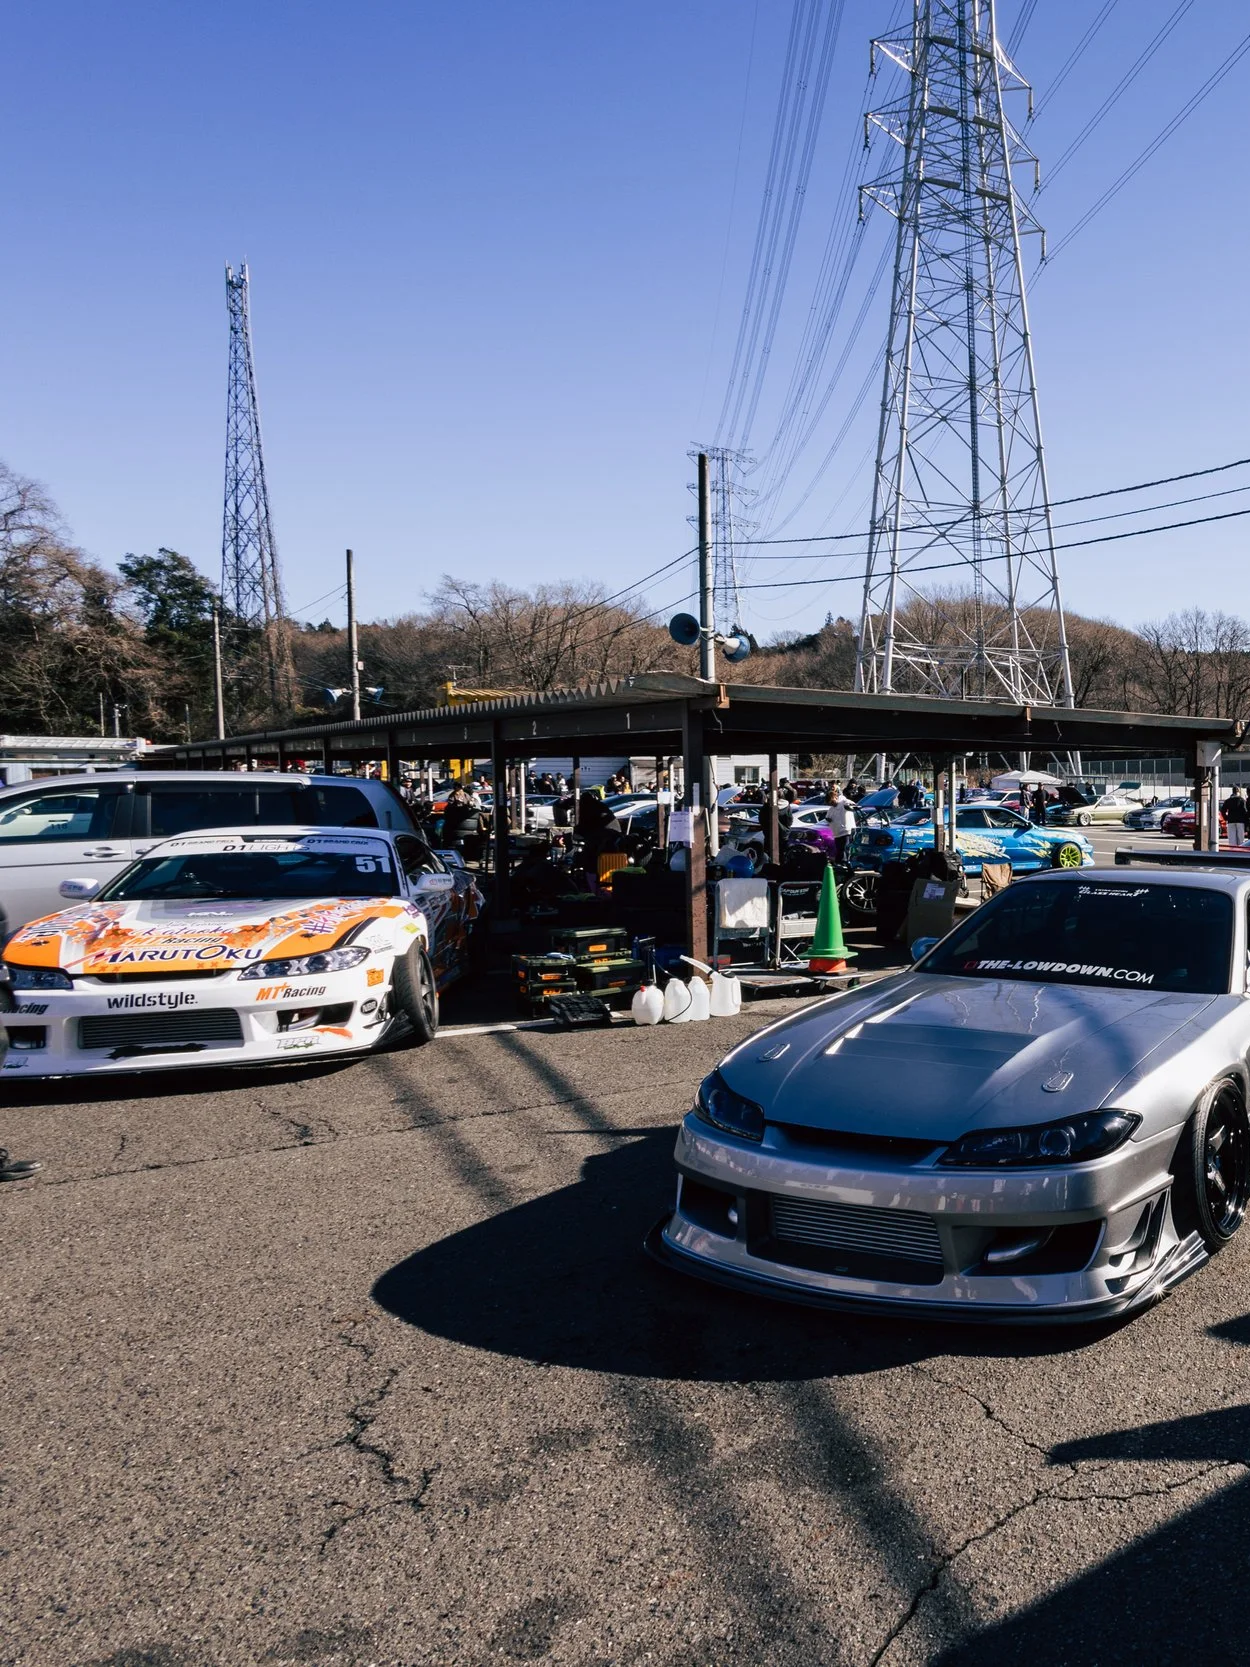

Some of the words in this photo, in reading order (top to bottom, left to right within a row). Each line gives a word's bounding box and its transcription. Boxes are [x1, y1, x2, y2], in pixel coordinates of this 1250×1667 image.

[531, 720, 538, 736] 2
[625, 711, 632, 730] 1
[355, 856, 392, 874] 51
[976, 959, 1155, 985] THE-LOWDOWN.COM
[282, 985, 327, 999] Racing
